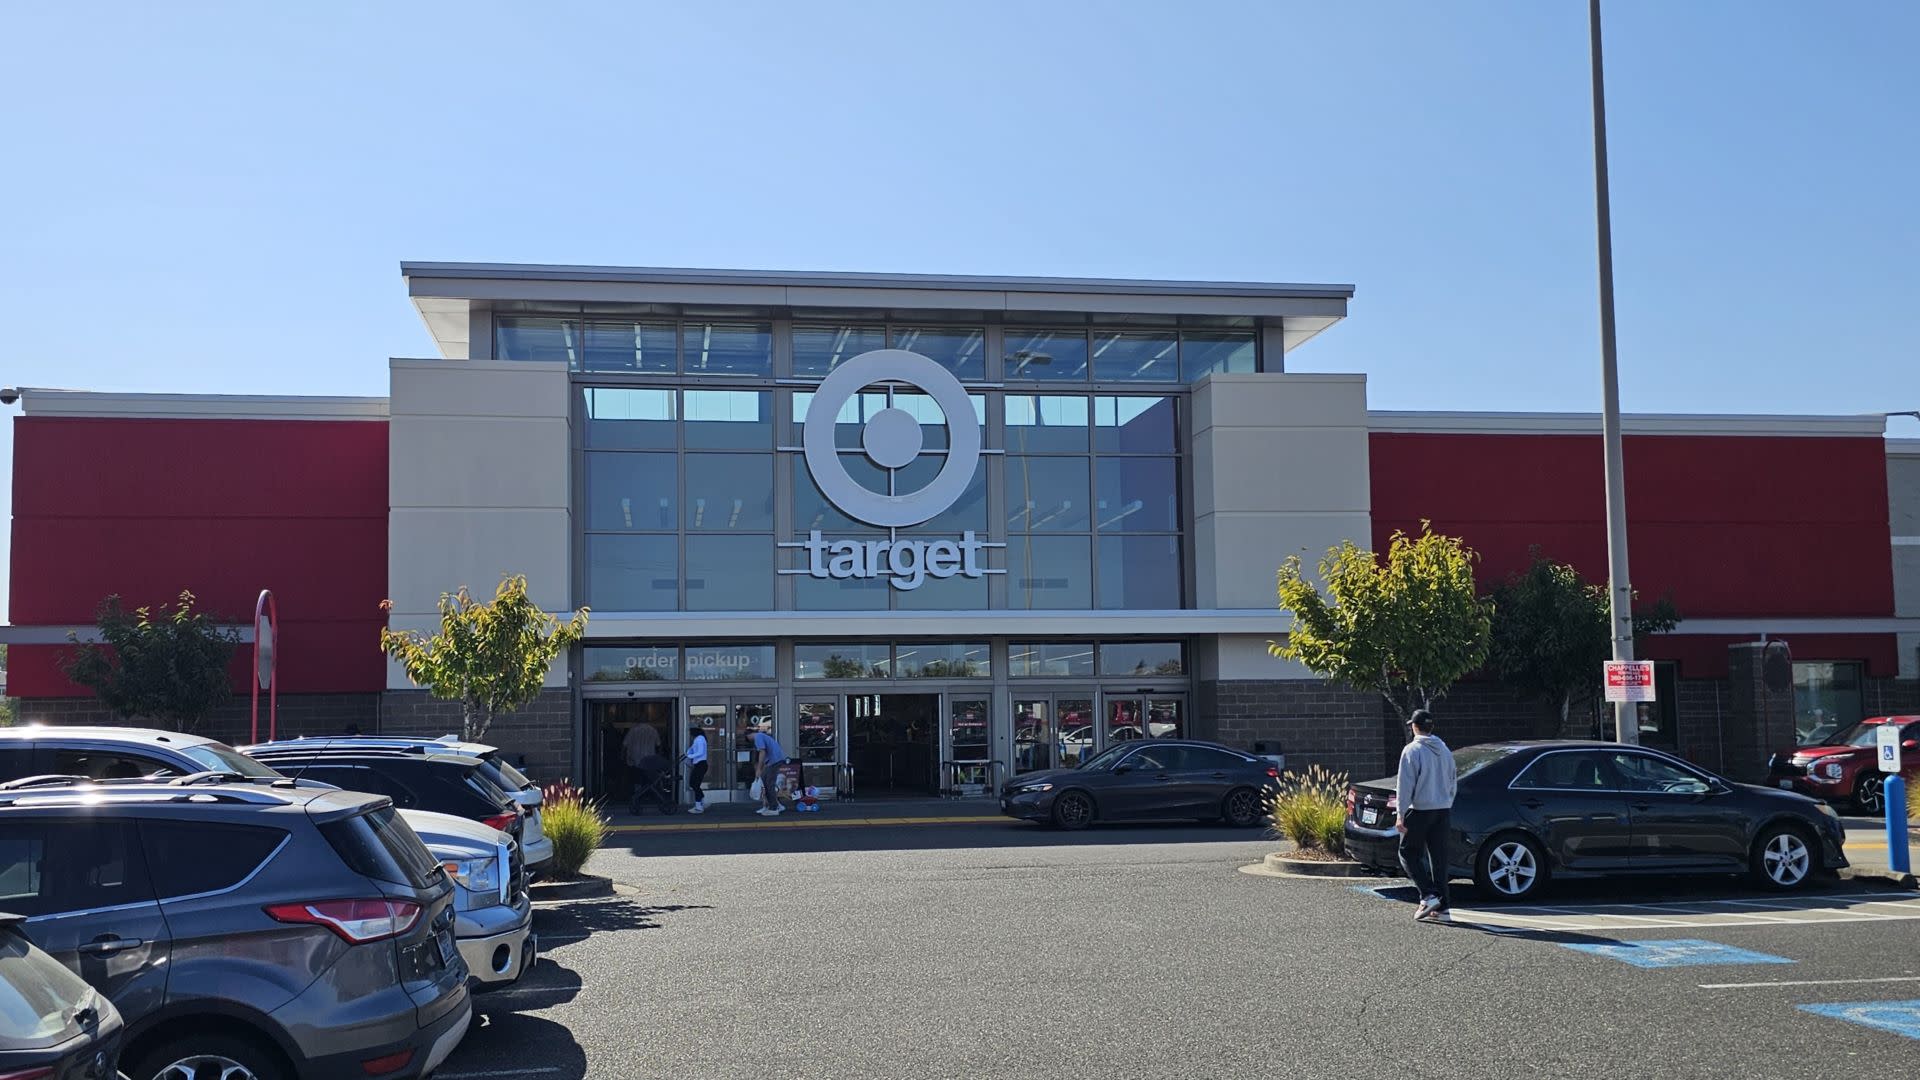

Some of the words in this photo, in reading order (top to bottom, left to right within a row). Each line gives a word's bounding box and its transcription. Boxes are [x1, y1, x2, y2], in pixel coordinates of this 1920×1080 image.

[805, 530, 983, 590] target
[625, 651, 676, 668] order
[686, 651, 750, 671] pickup
